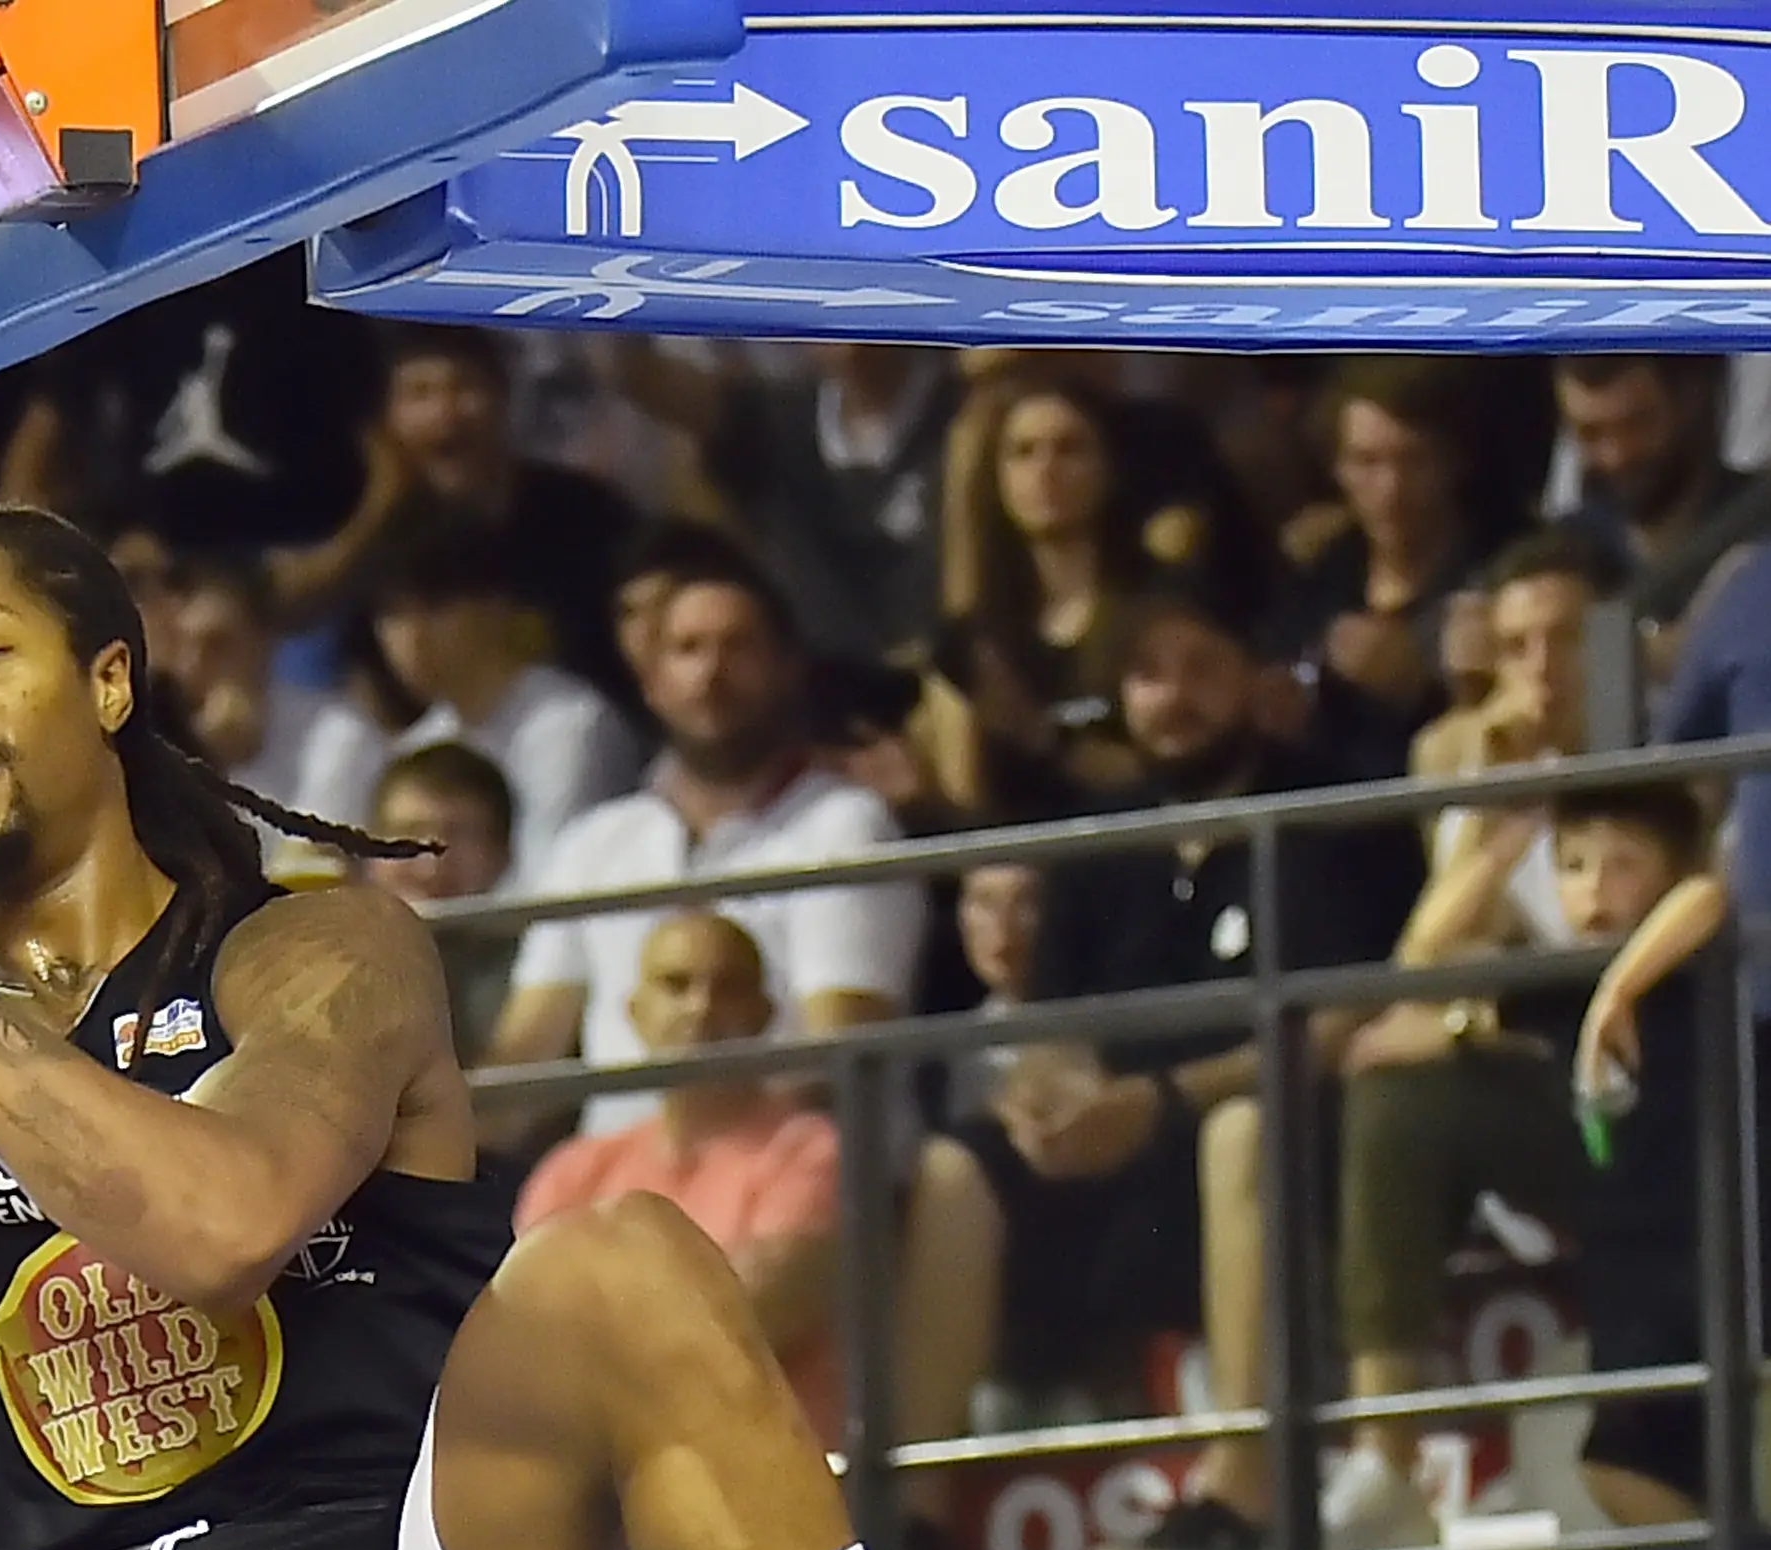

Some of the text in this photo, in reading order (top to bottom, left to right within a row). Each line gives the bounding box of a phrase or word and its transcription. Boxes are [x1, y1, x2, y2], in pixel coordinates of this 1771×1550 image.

[838, 45, 1771, 236] saniR
[27, 1306, 221, 1416] WILD
[40, 1364, 244, 1484] WEST
